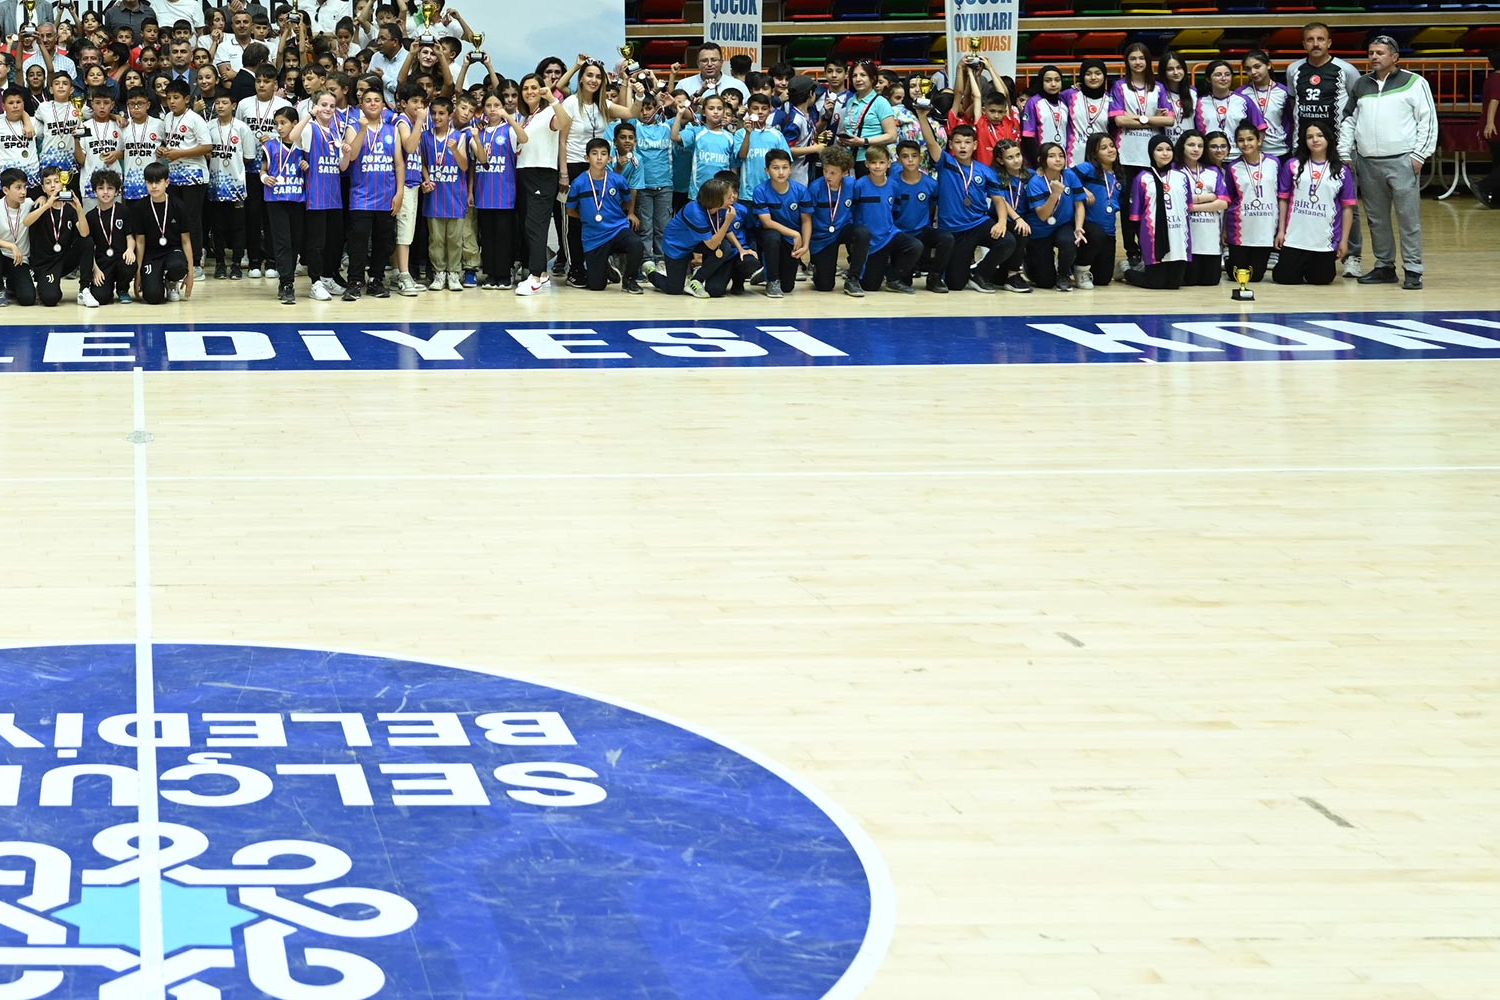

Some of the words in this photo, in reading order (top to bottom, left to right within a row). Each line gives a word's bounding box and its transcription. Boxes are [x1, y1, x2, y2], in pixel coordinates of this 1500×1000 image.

[953, 12, 1012, 32] OYUNLARI
[710, 21, 758, 43] OYUNLARI
[1305, 88, 1321, 101] 32
[285, 163, 297, 175] 14
[430, 164, 458, 174] LKAN
[1293, 207, 1327, 218] Pastanesi
